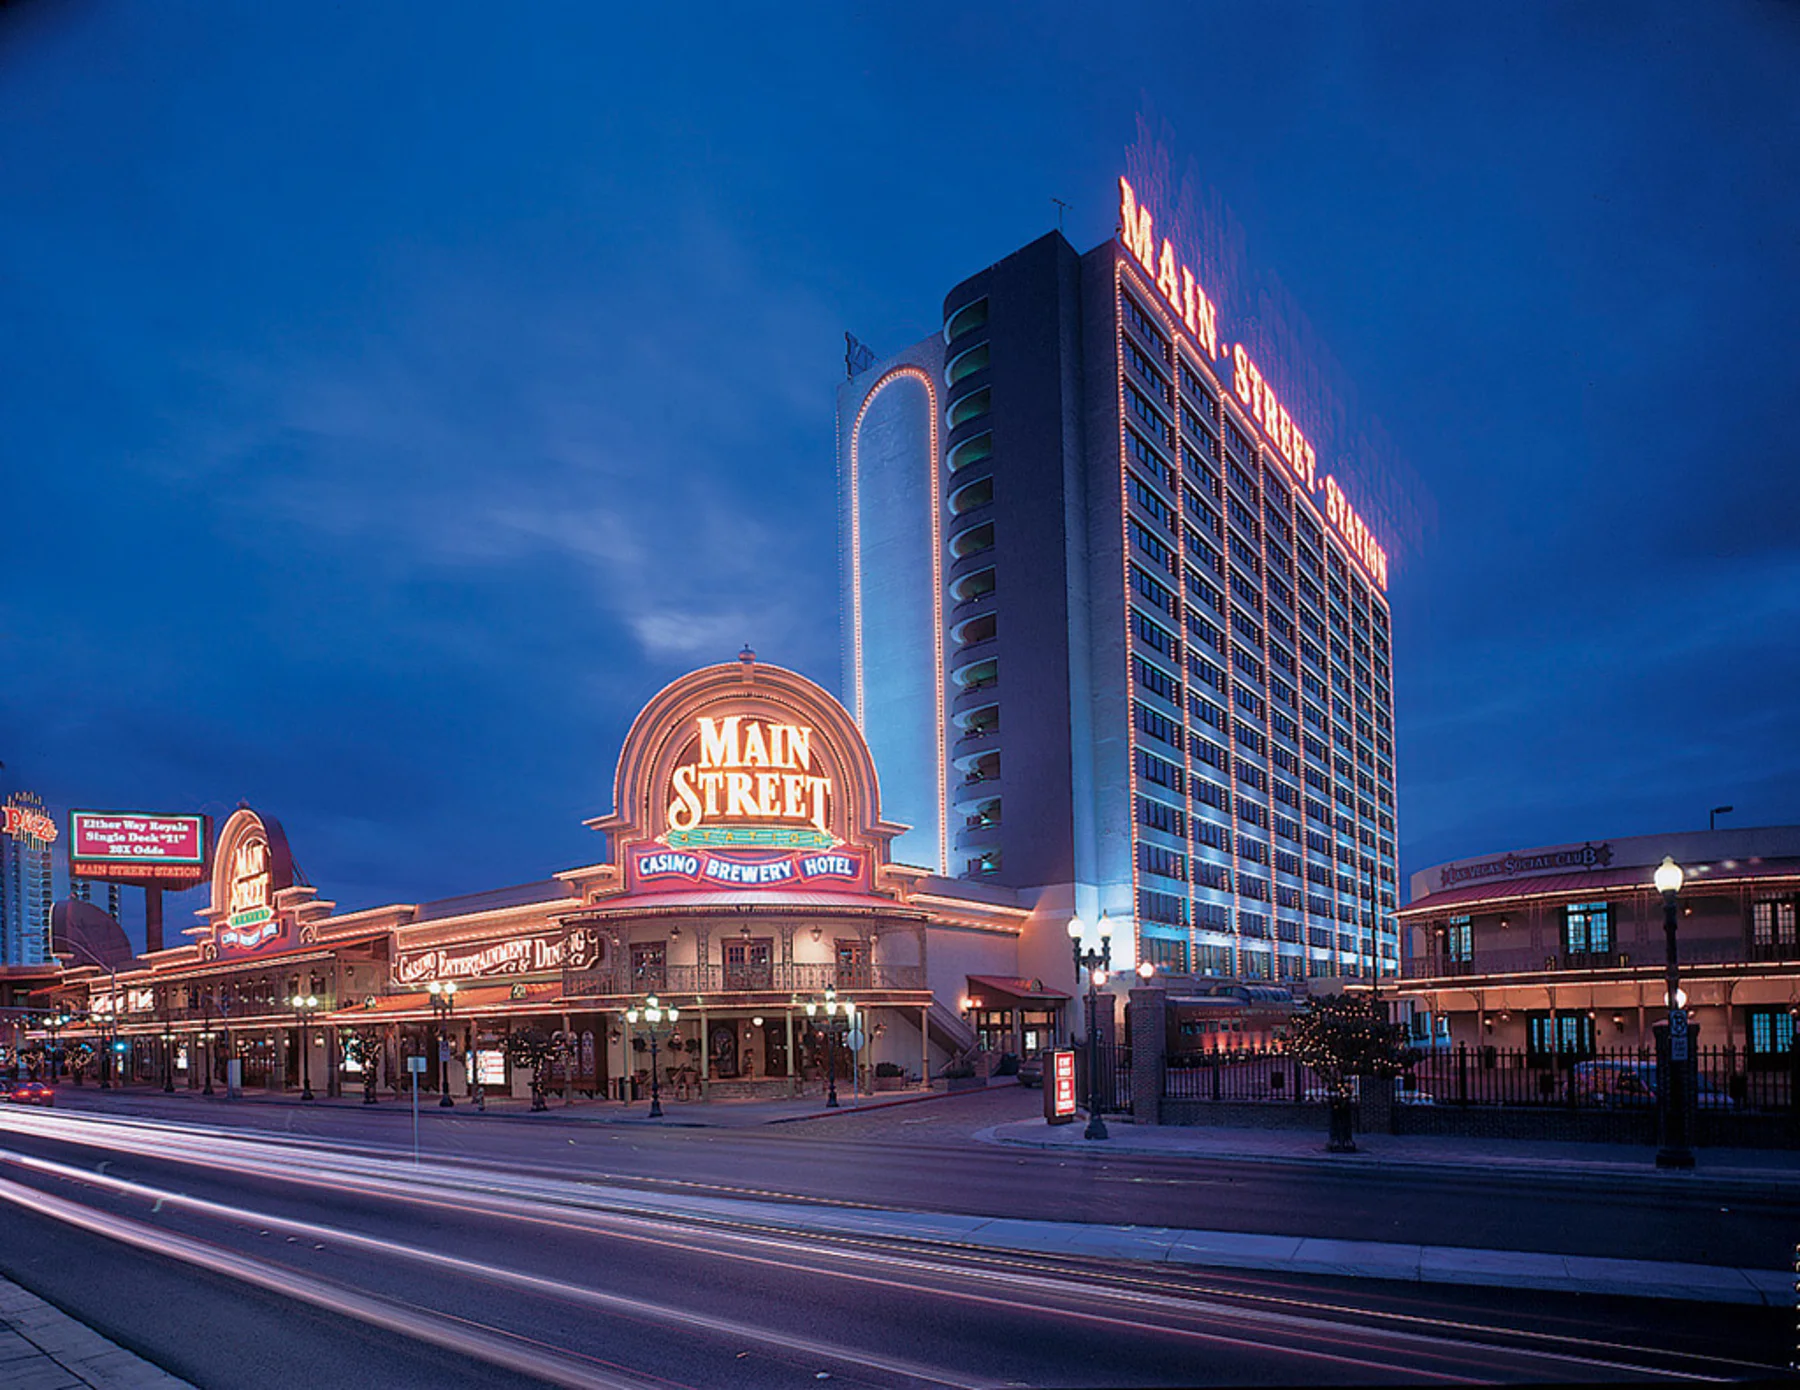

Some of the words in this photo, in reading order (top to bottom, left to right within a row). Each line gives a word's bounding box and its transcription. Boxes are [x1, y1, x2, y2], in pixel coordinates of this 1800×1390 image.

[1119, 176, 1216, 361] MAIN
[1232, 343, 1316, 495] STREET
[1324, 474, 1388, 591] STATION
[697, 716, 812, 770] MAIN
[669, 762, 832, 834] STREET
[83, 819, 121, 829] Either
[123, 820, 146, 831] Way
[150, 822, 189, 833] Royals
[86, 832, 126, 842] Single
[128, 832, 158, 842] Deck
[680, 832, 824, 846] STATION
[133, 845, 164, 854] Odds
[75, 864, 107, 875] MAIN
[108, 865, 153, 876] STREET
[154, 866, 201, 877] STATION
[639, 853, 698, 876] CASINO
[706, 858, 794, 884] BREWERY
[805, 855, 853, 876] HOTEL
[1448, 868, 1467, 884] LAS
[1470, 864, 1501, 878] VEGAS
[1504, 856, 1549, 874] SOCIAL
[1556, 848, 1597, 866] CLUB
[400, 952, 437, 981] CASINO
[438, 940, 532, 977] ENTERTAINMENT
[534, 929, 585, 969] DINNG
